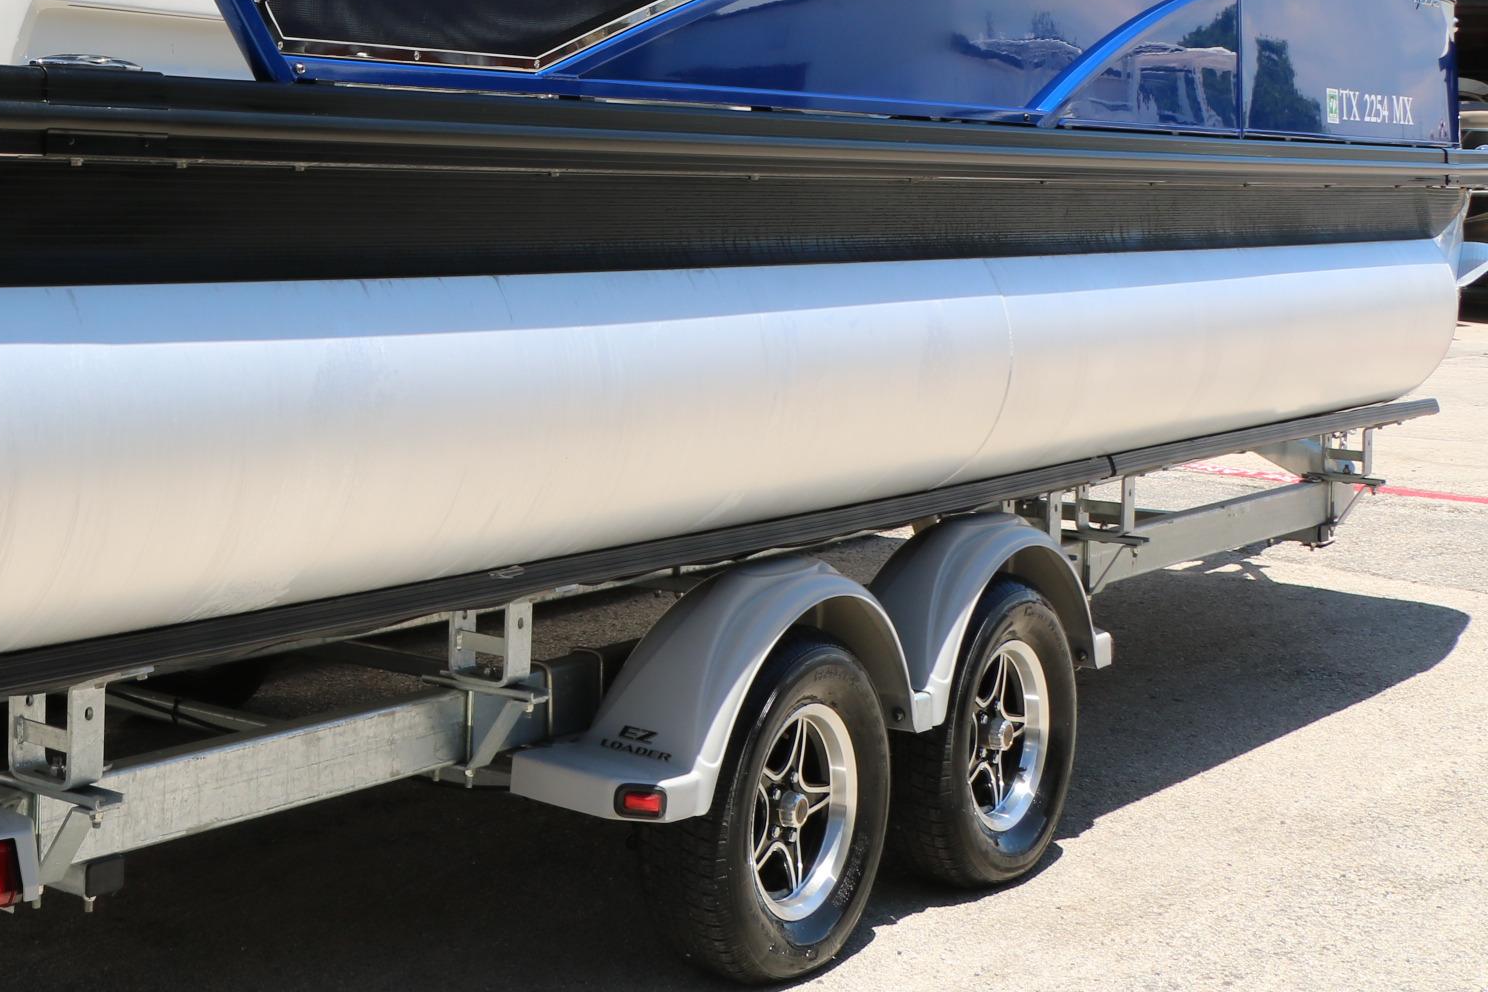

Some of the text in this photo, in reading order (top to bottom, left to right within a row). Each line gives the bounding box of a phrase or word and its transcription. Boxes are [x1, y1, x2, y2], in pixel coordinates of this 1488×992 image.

[1339, 89, 1360, 121] TX
[1364, 94, 1389, 123] 2254
[1392, 96, 1414, 125] MX
[619, 724, 658, 745] EZ
[600, 739, 672, 762] LOADER
